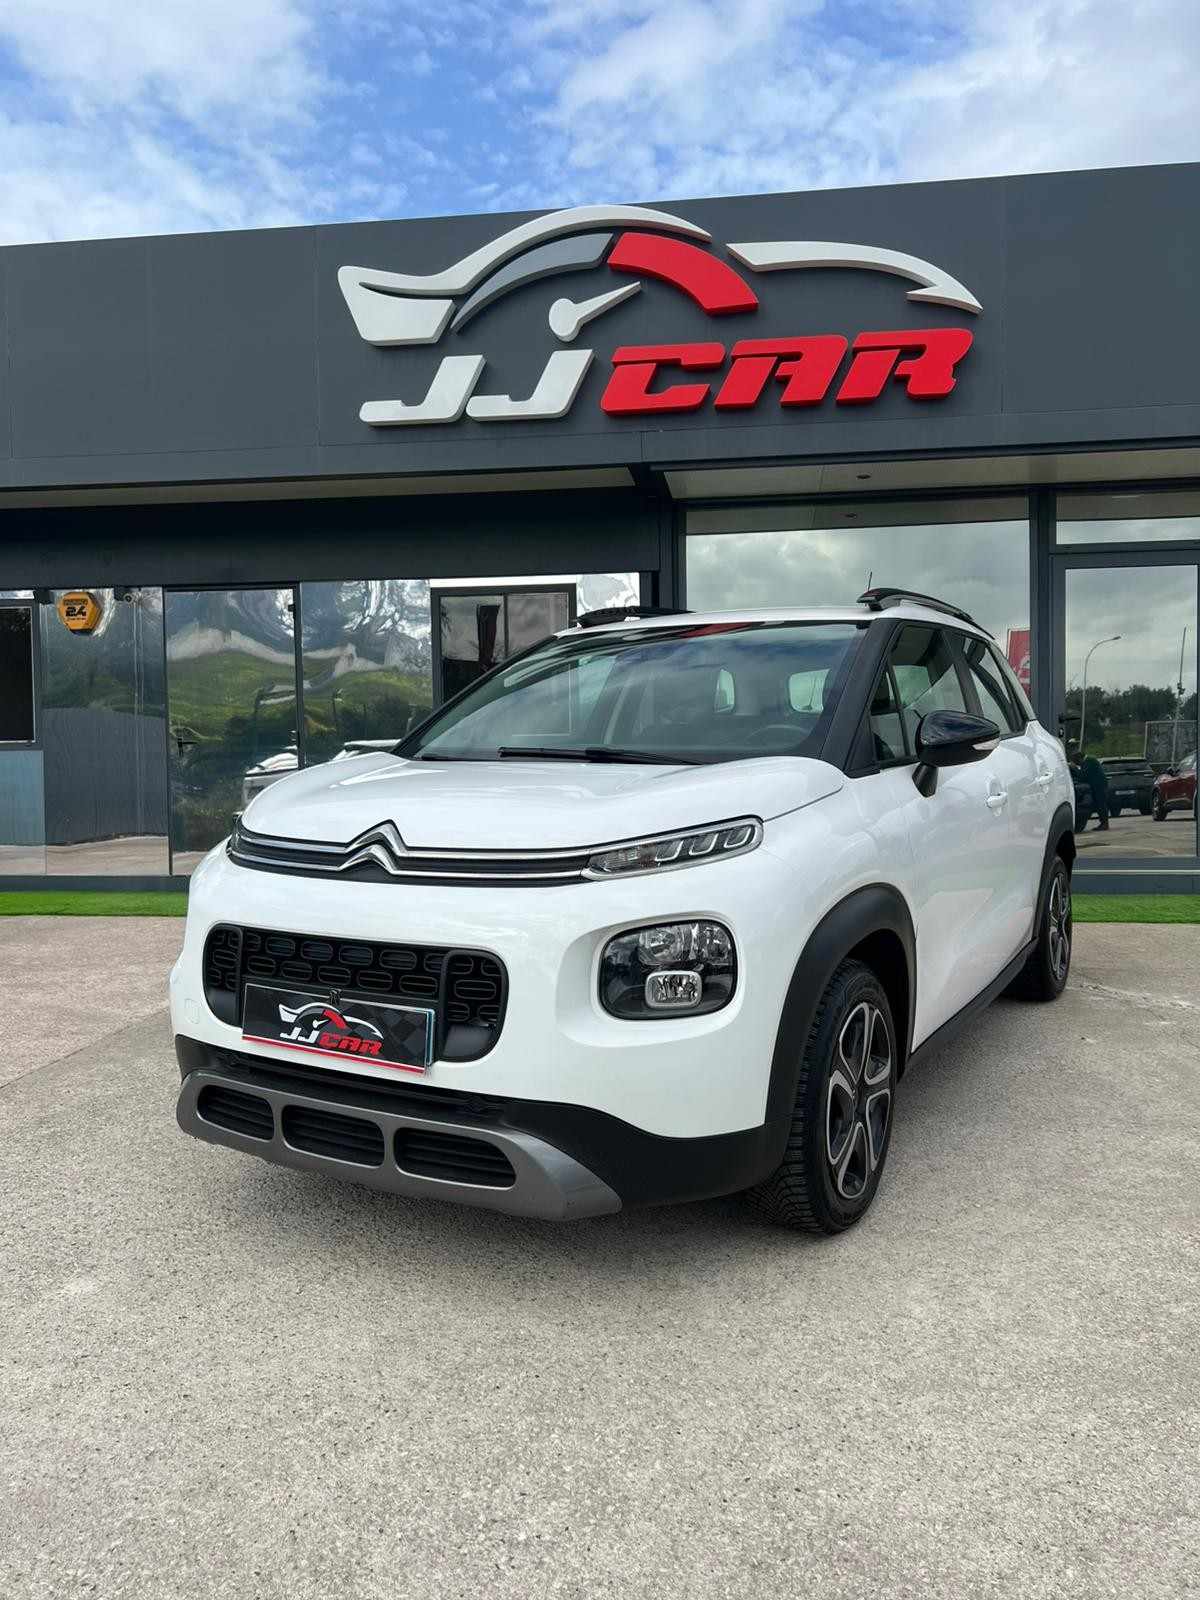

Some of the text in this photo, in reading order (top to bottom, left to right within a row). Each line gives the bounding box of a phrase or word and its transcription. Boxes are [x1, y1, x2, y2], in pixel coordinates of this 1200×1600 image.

[359, 327, 974, 427] JJ CAR
[279, 1027, 384, 1055] JJ CAR
